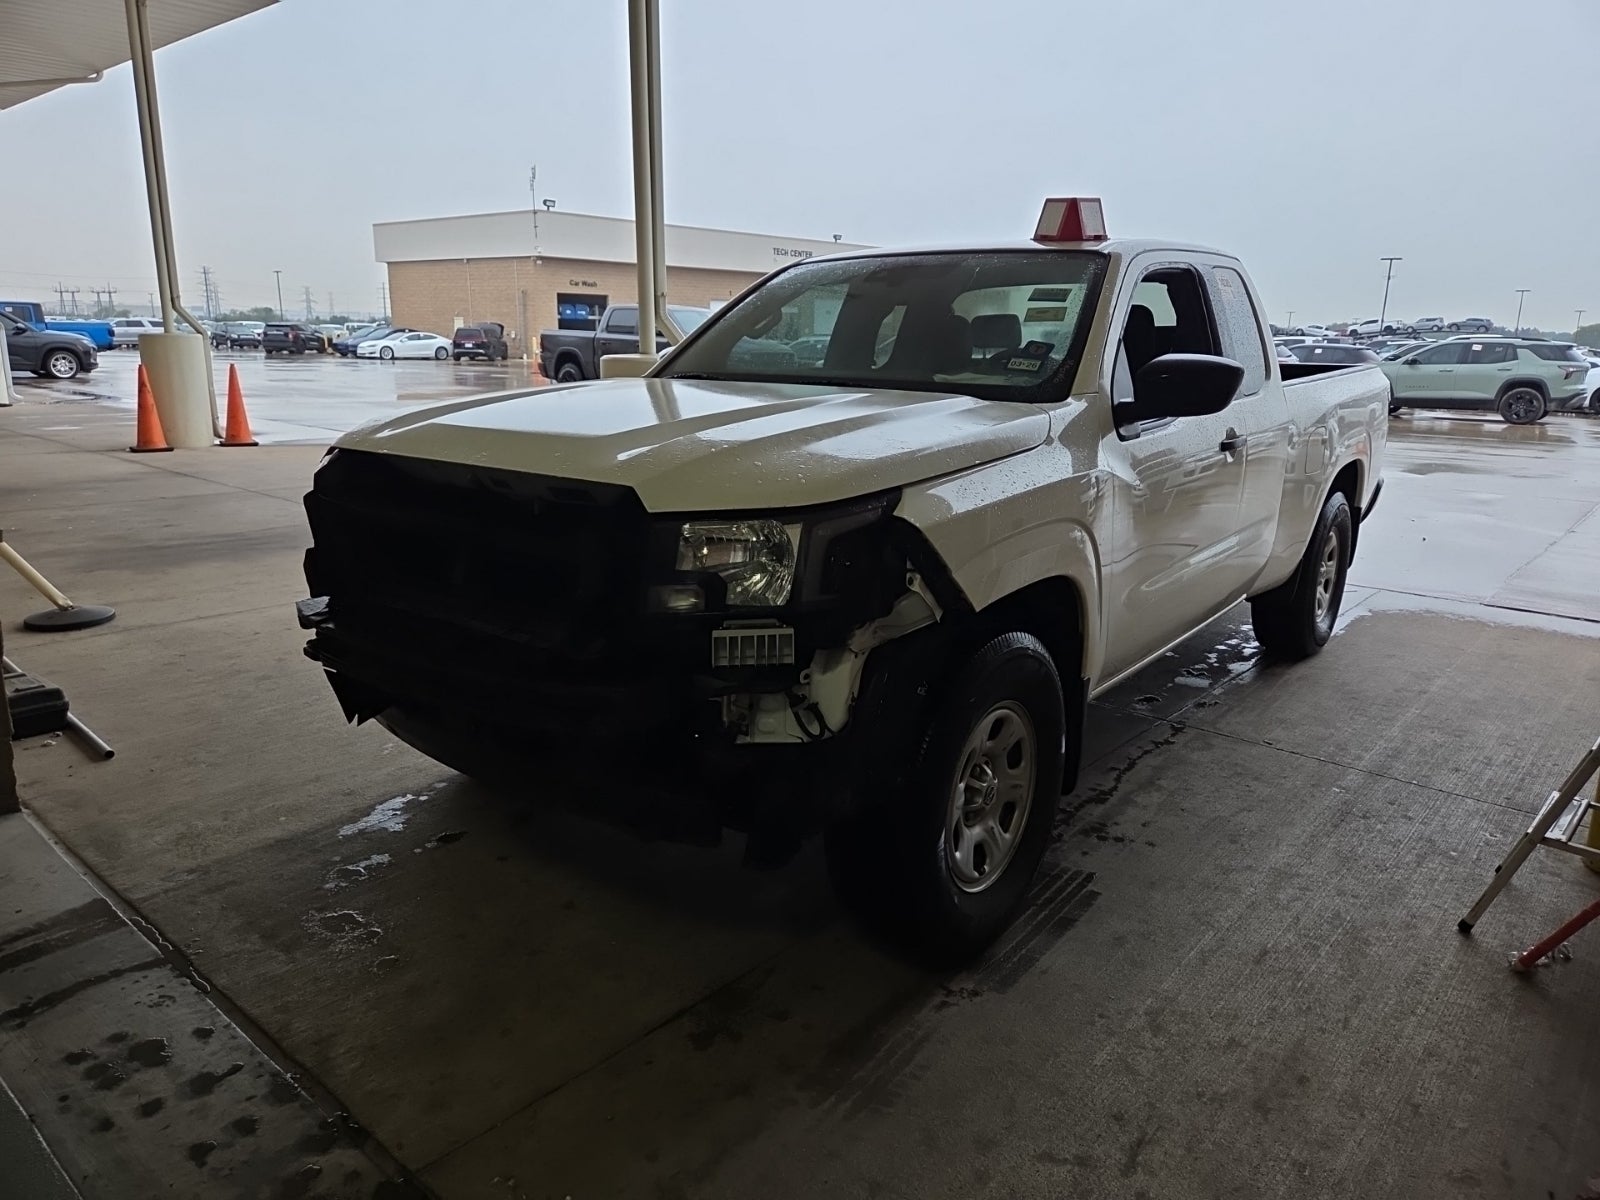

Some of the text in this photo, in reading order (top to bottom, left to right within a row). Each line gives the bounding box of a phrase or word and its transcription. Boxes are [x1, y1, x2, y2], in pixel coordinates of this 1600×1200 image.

[773, 247, 813, 258] TECH CENTER
[569, 279, 598, 288] Car Wash
